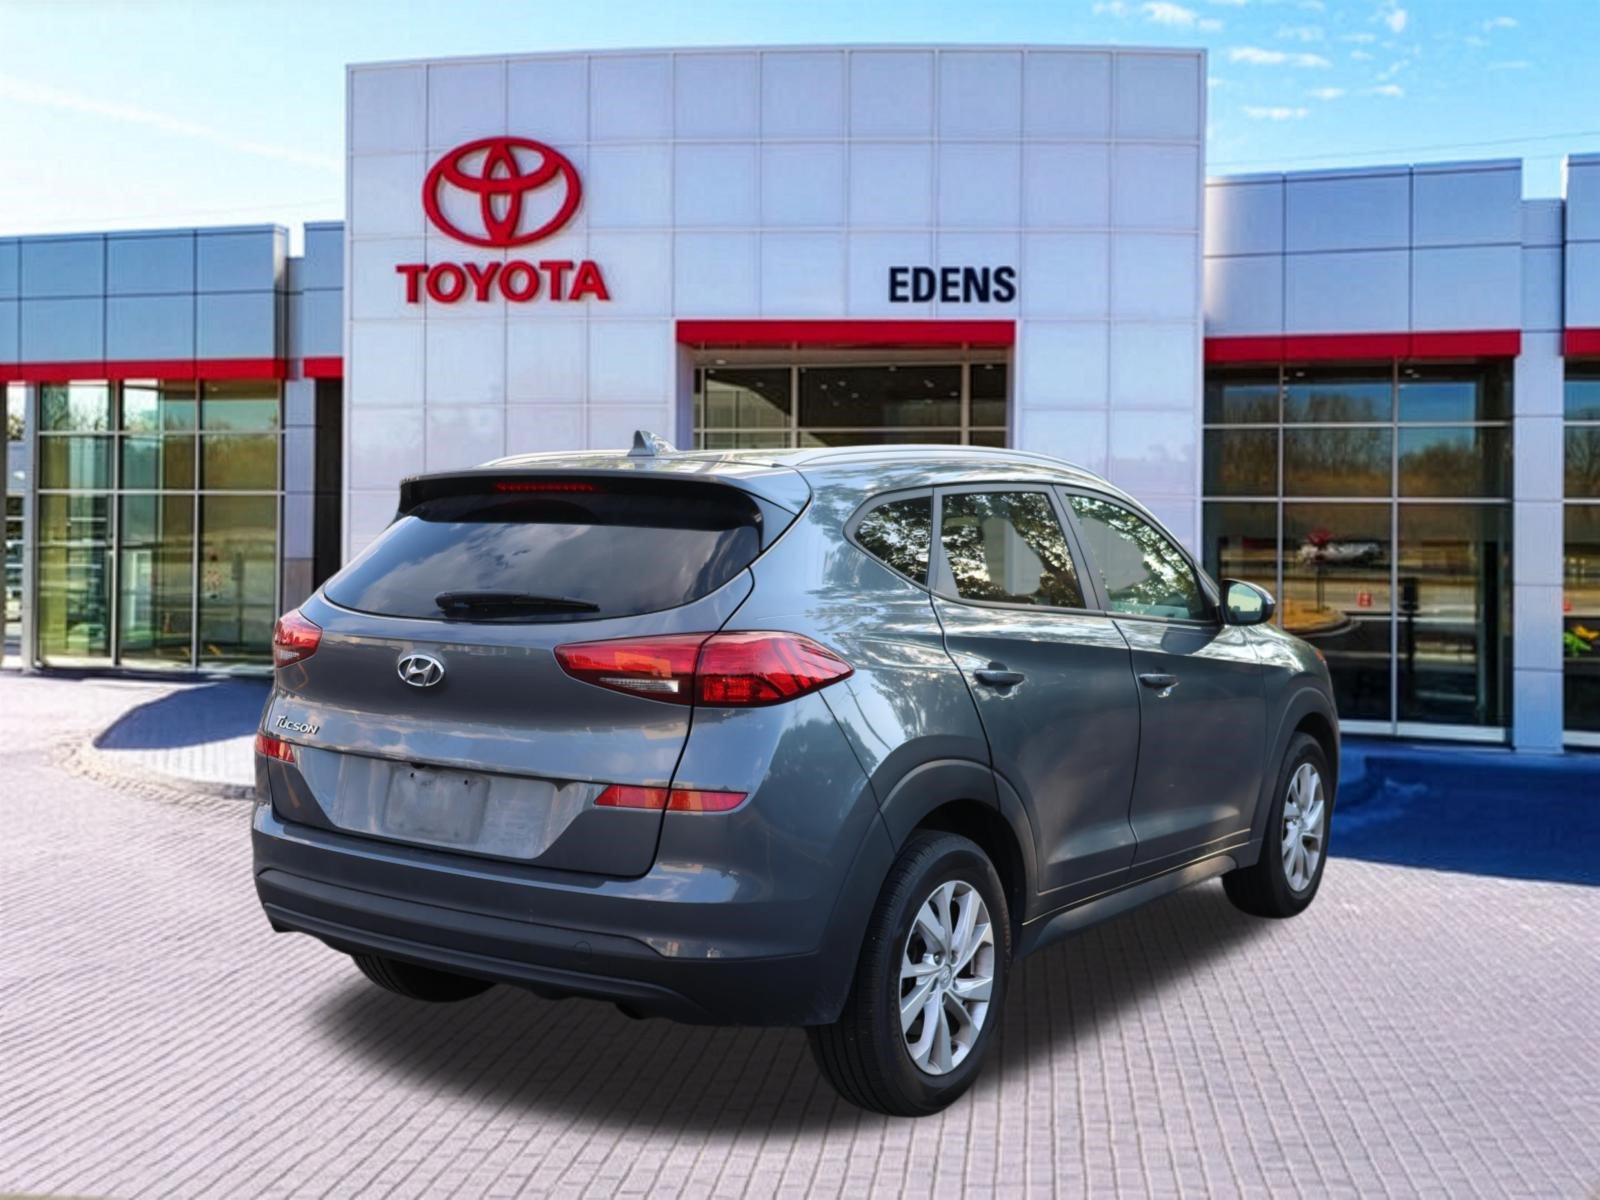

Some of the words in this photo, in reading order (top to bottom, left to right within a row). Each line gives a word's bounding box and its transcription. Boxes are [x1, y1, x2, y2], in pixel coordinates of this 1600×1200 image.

[395, 259, 611, 304] TOYOTA
[889, 266, 1017, 303] EDENS
[275, 715, 320, 735] TUCSON
